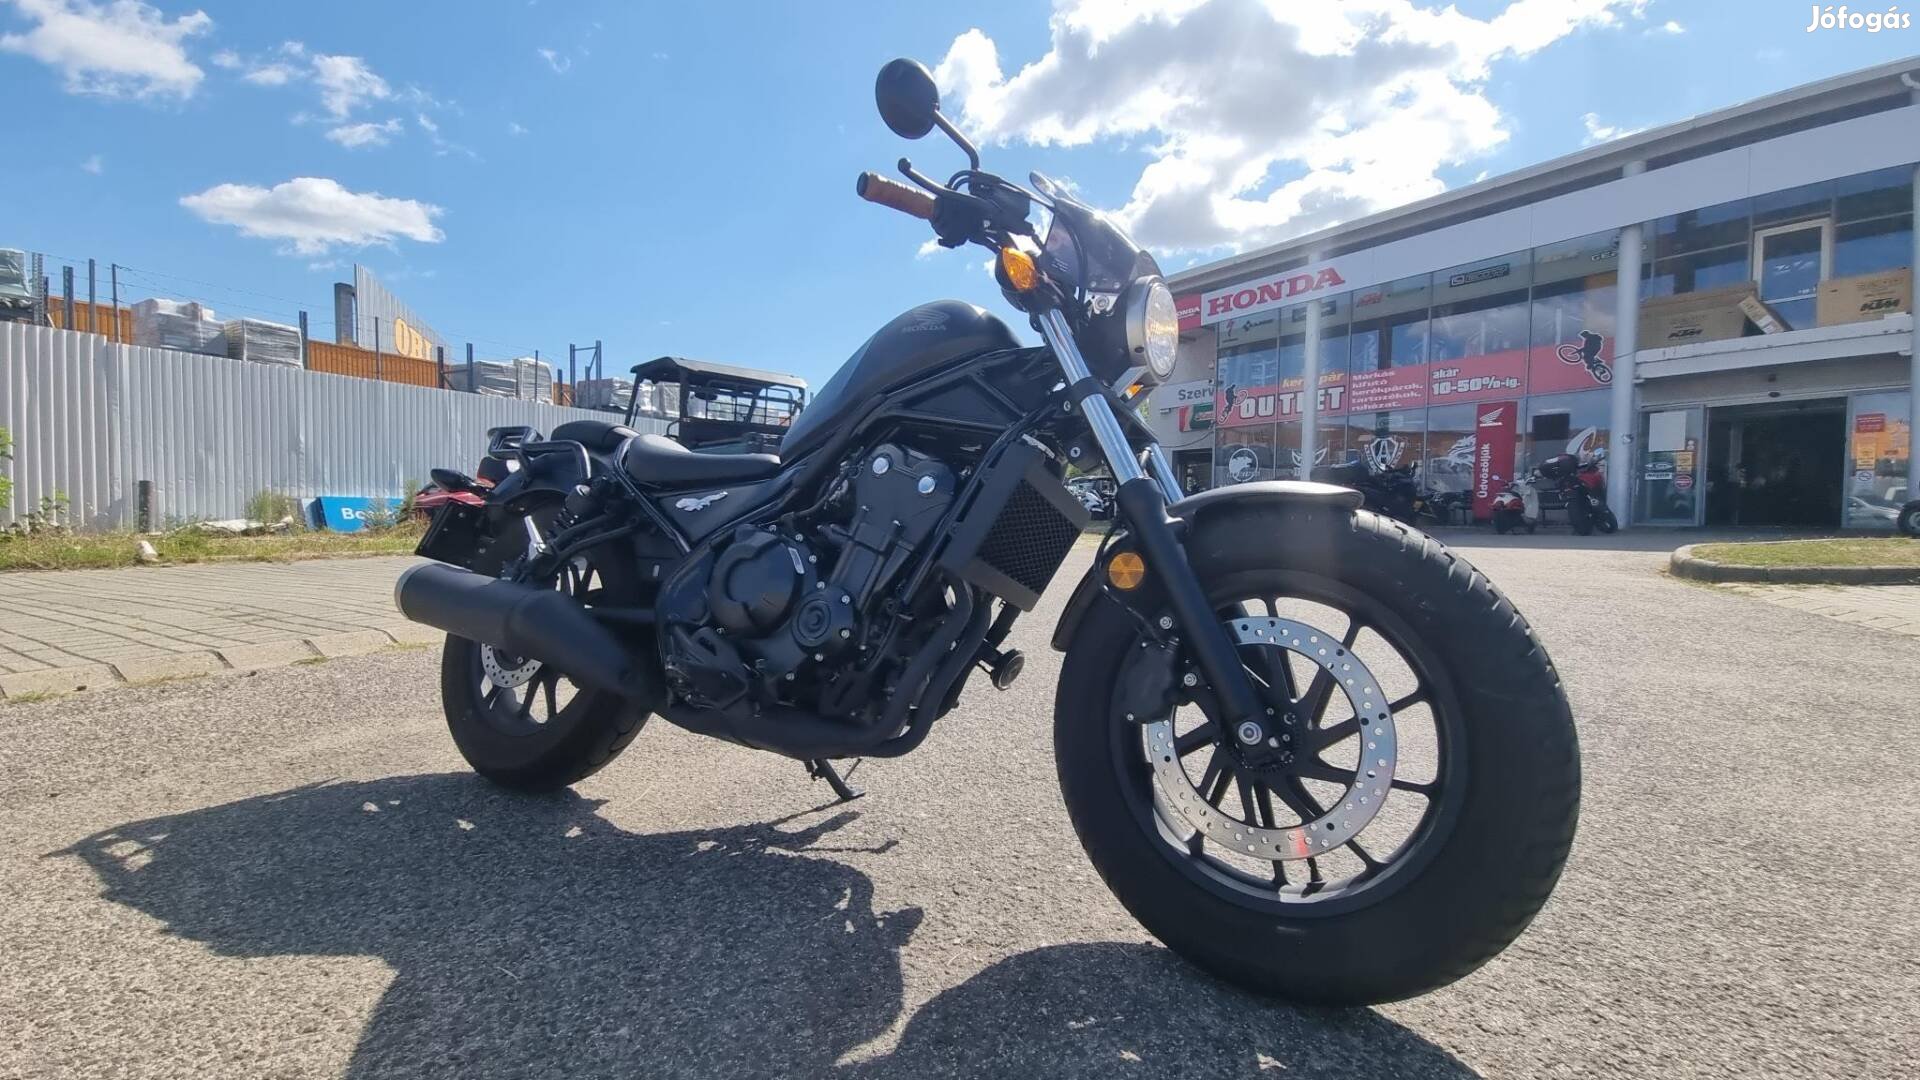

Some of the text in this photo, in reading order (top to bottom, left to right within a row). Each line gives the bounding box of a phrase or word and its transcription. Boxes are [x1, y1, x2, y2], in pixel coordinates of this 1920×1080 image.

[1207, 267, 1346, 317] HONDA
[1176, 306, 1200, 318] ONDA
[901, 324, 947, 333] HONDA
[1282, 371, 1345, 389] kerpár
[1432, 367, 1460, 379] akár
[1476, 443, 1491, 498] Üdvözöljük
